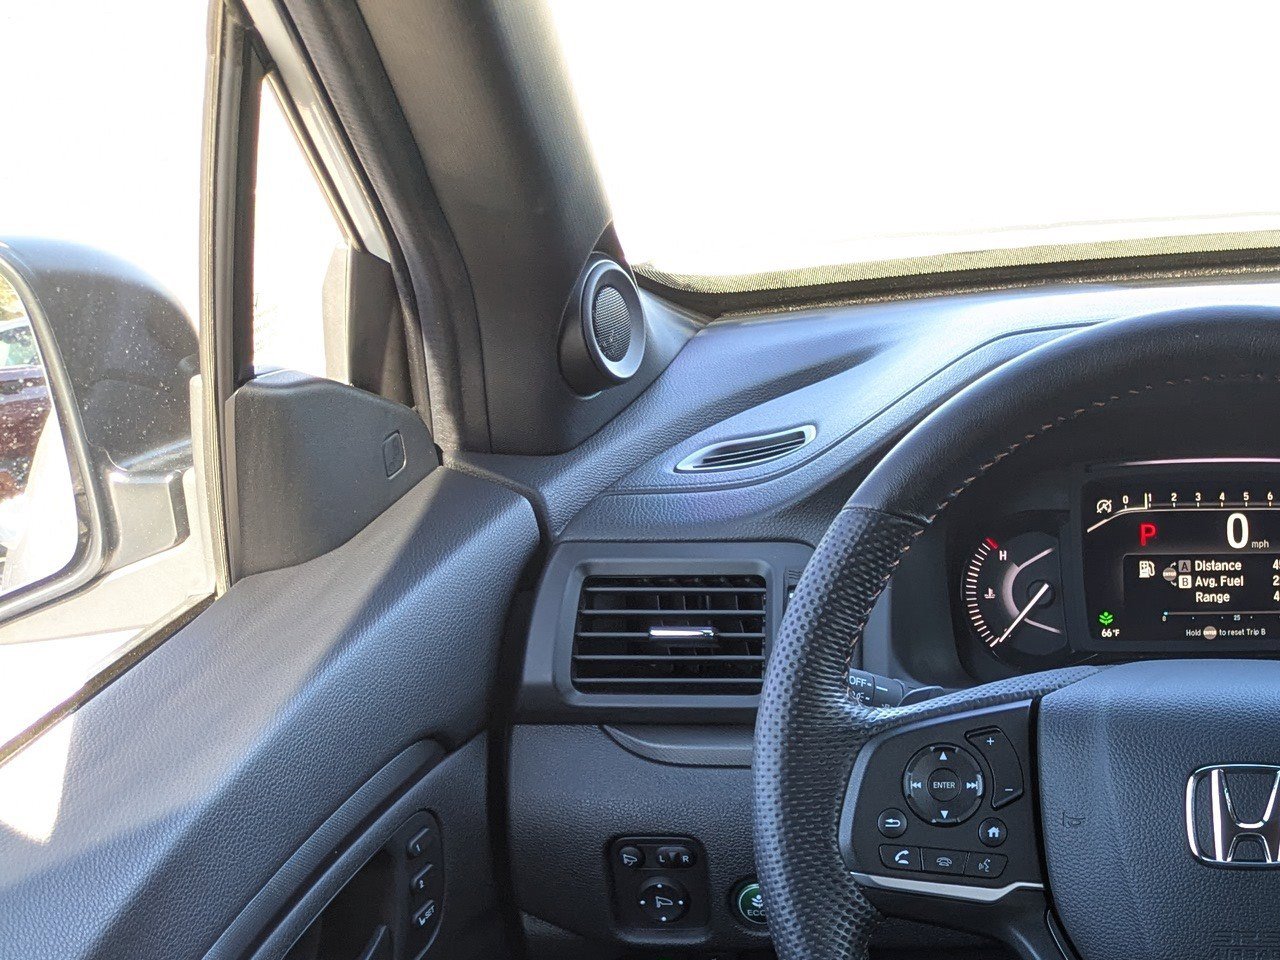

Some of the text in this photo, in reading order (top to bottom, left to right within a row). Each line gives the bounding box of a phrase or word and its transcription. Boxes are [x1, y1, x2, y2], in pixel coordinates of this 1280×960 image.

[1123, 495, 1128, 504] 0
[1148, 493, 1152, 502] 1
[1171, 493, 1177, 501] 2
[1195, 492, 1201, 501] 3
[1219, 492, 1225, 501] 4
[1243, 492, 1249, 500] 5
[1267, 492, 1273, 500] 6
[1140, 523, 1156, 546] P
[1226, 513, 1269, 549] 0 mph
[999, 550, 1007, 561] H
[1195, 560, 1242, 571] Distance
[1195, 576, 1218, 588] Avg.
[1220, 576, 1244, 587] Fuel
[1196, 592, 1230, 604] Range
[849, 676, 867, 687] OFF
[933, 781, 956, 789] ENTER
[659, 855, 665, 863] L
[682, 855, 689, 863] R
